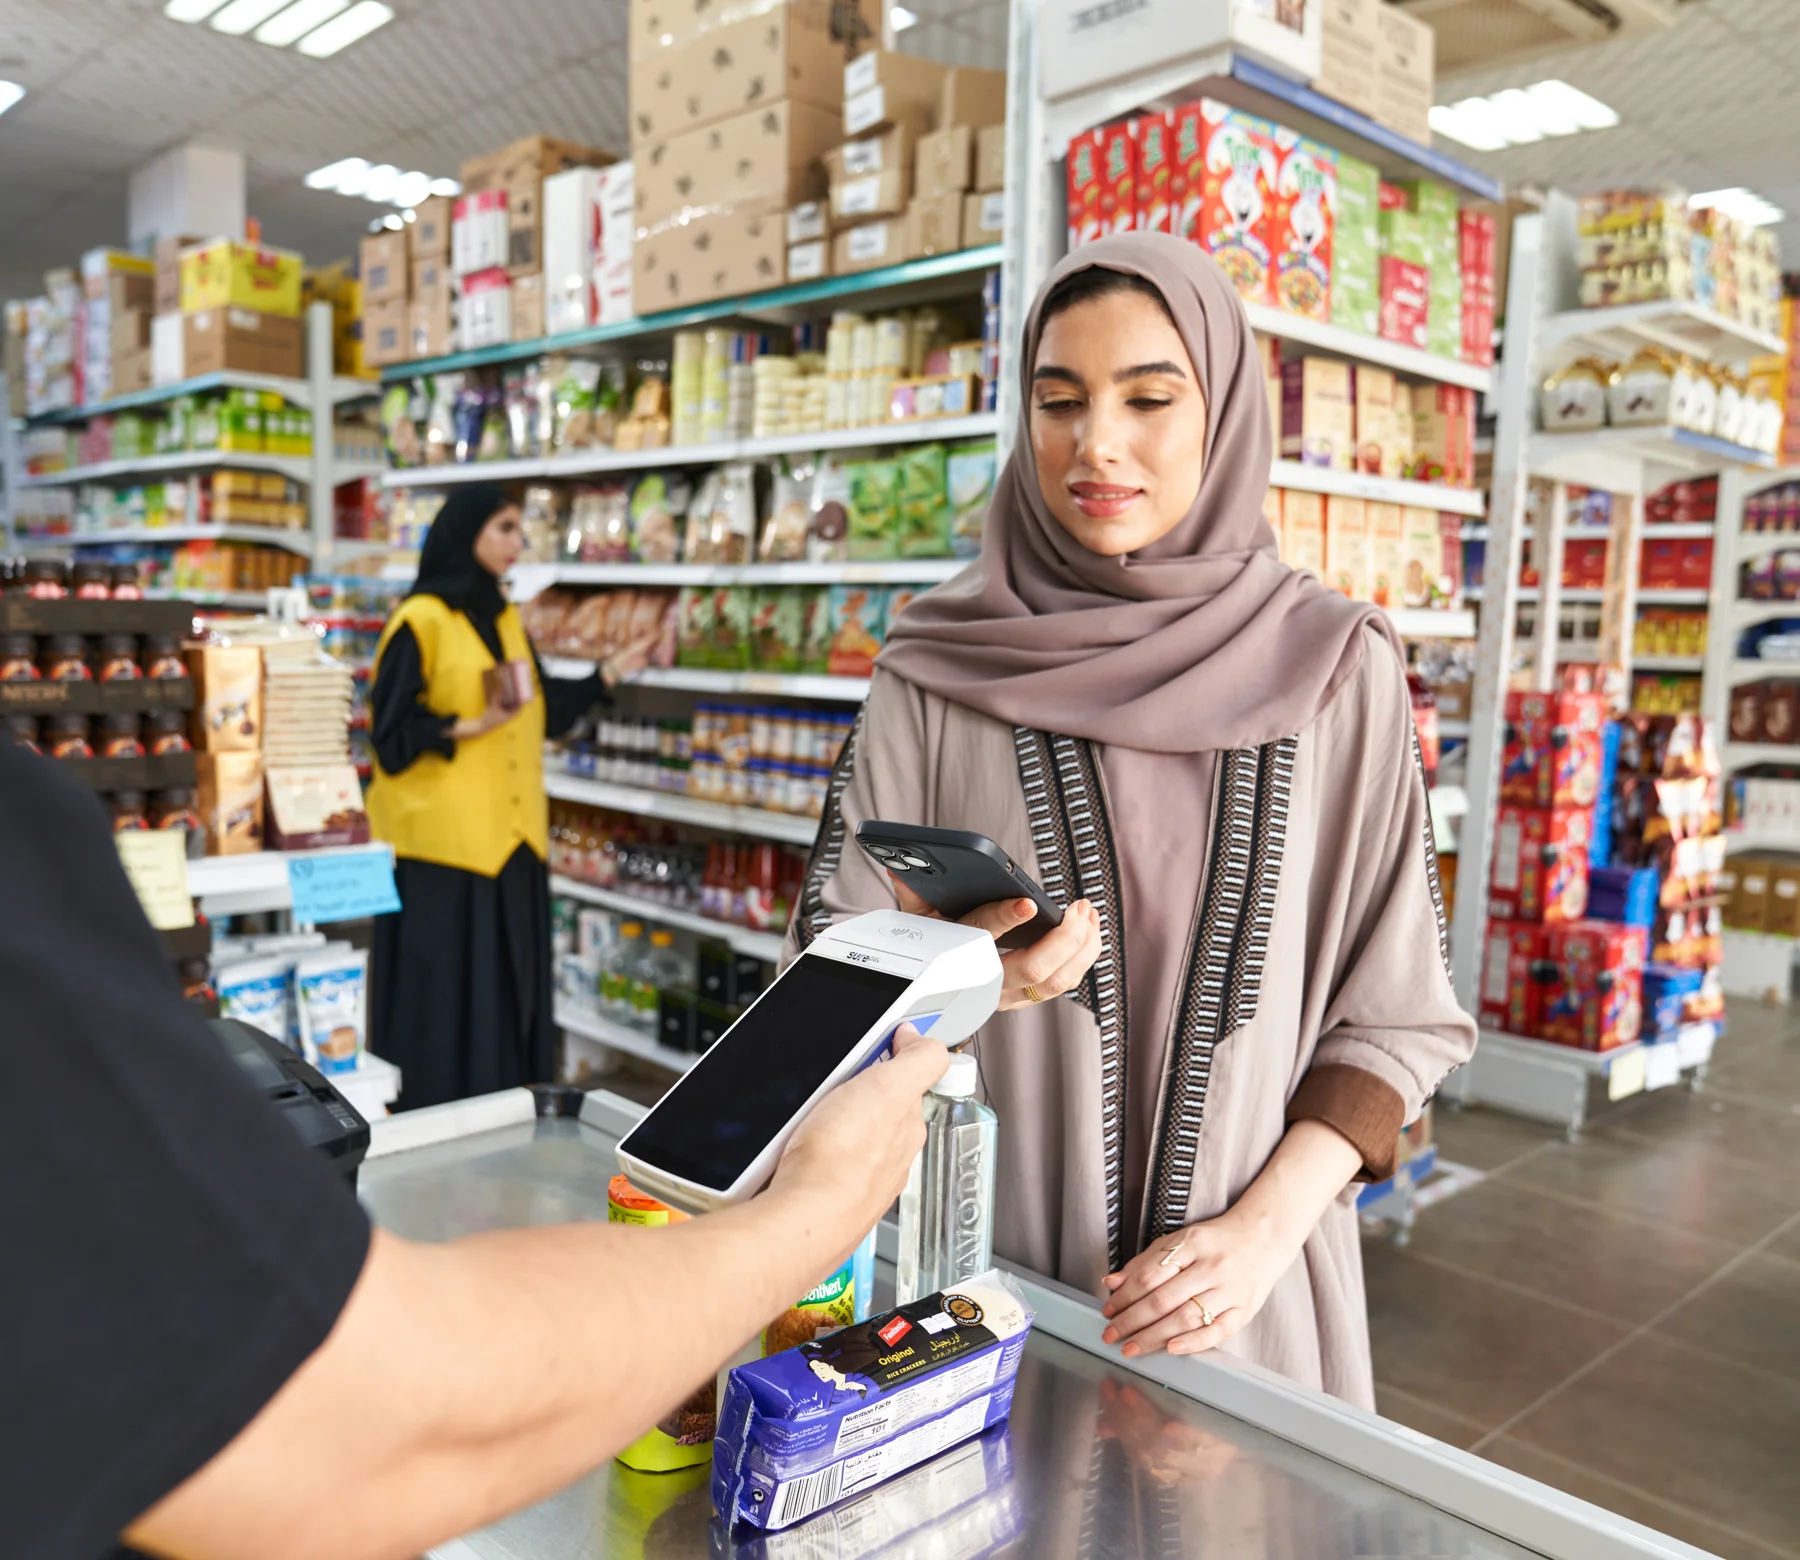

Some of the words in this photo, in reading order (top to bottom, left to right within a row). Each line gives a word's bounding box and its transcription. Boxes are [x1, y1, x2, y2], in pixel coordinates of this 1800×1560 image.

[803, 1277, 843, 1301] antiveri
[878, 1346, 915, 1366] Original
[886, 1370, 899, 1380] RICE
[899, 1359, 926, 1373] CRACKERS
[845, 1409, 873, 1422] Nutrition
[874, 1400, 891, 1412] Facts
[871, 1424, 886, 1435] 101
